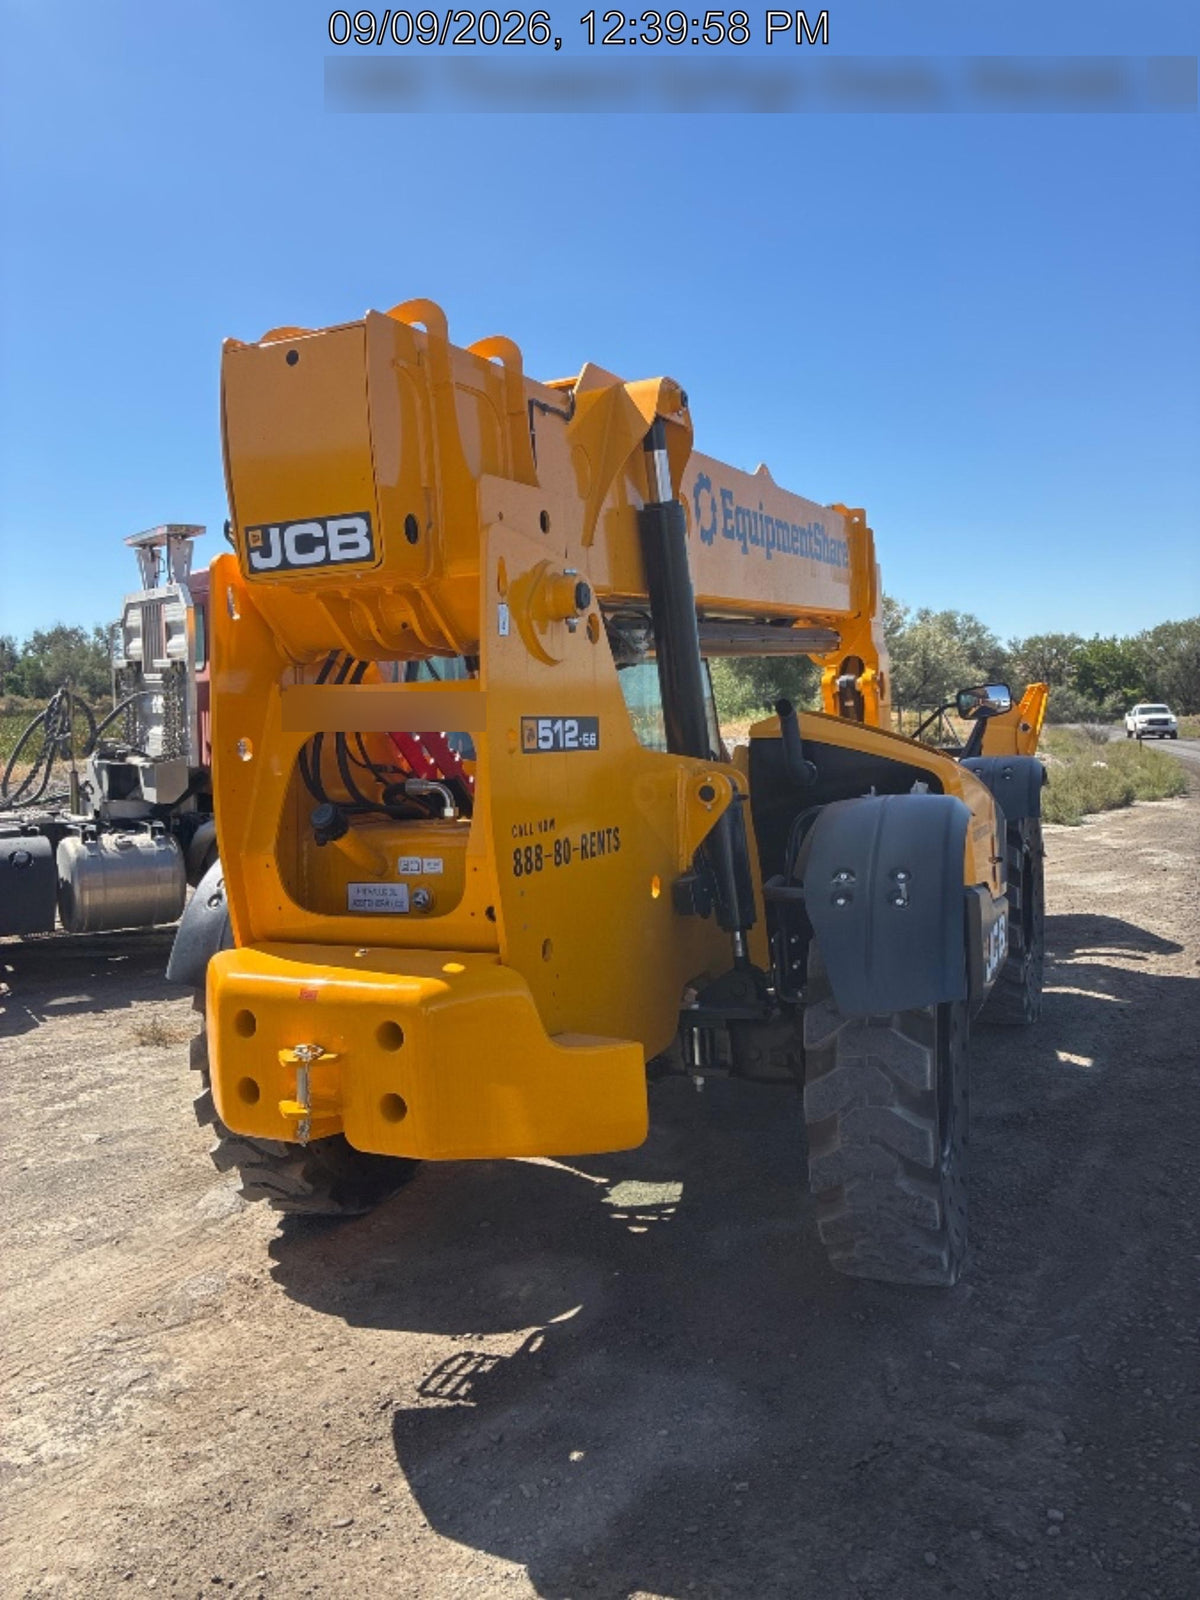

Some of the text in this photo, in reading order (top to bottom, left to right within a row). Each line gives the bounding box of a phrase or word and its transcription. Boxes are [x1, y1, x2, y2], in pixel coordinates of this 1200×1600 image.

[249, 517, 371, 570] JCB
[720, 487, 849, 569] EquipmentShare
[511, 822, 534, 838] CALL
[513, 826, 621, 877] 888-80-RENTS
